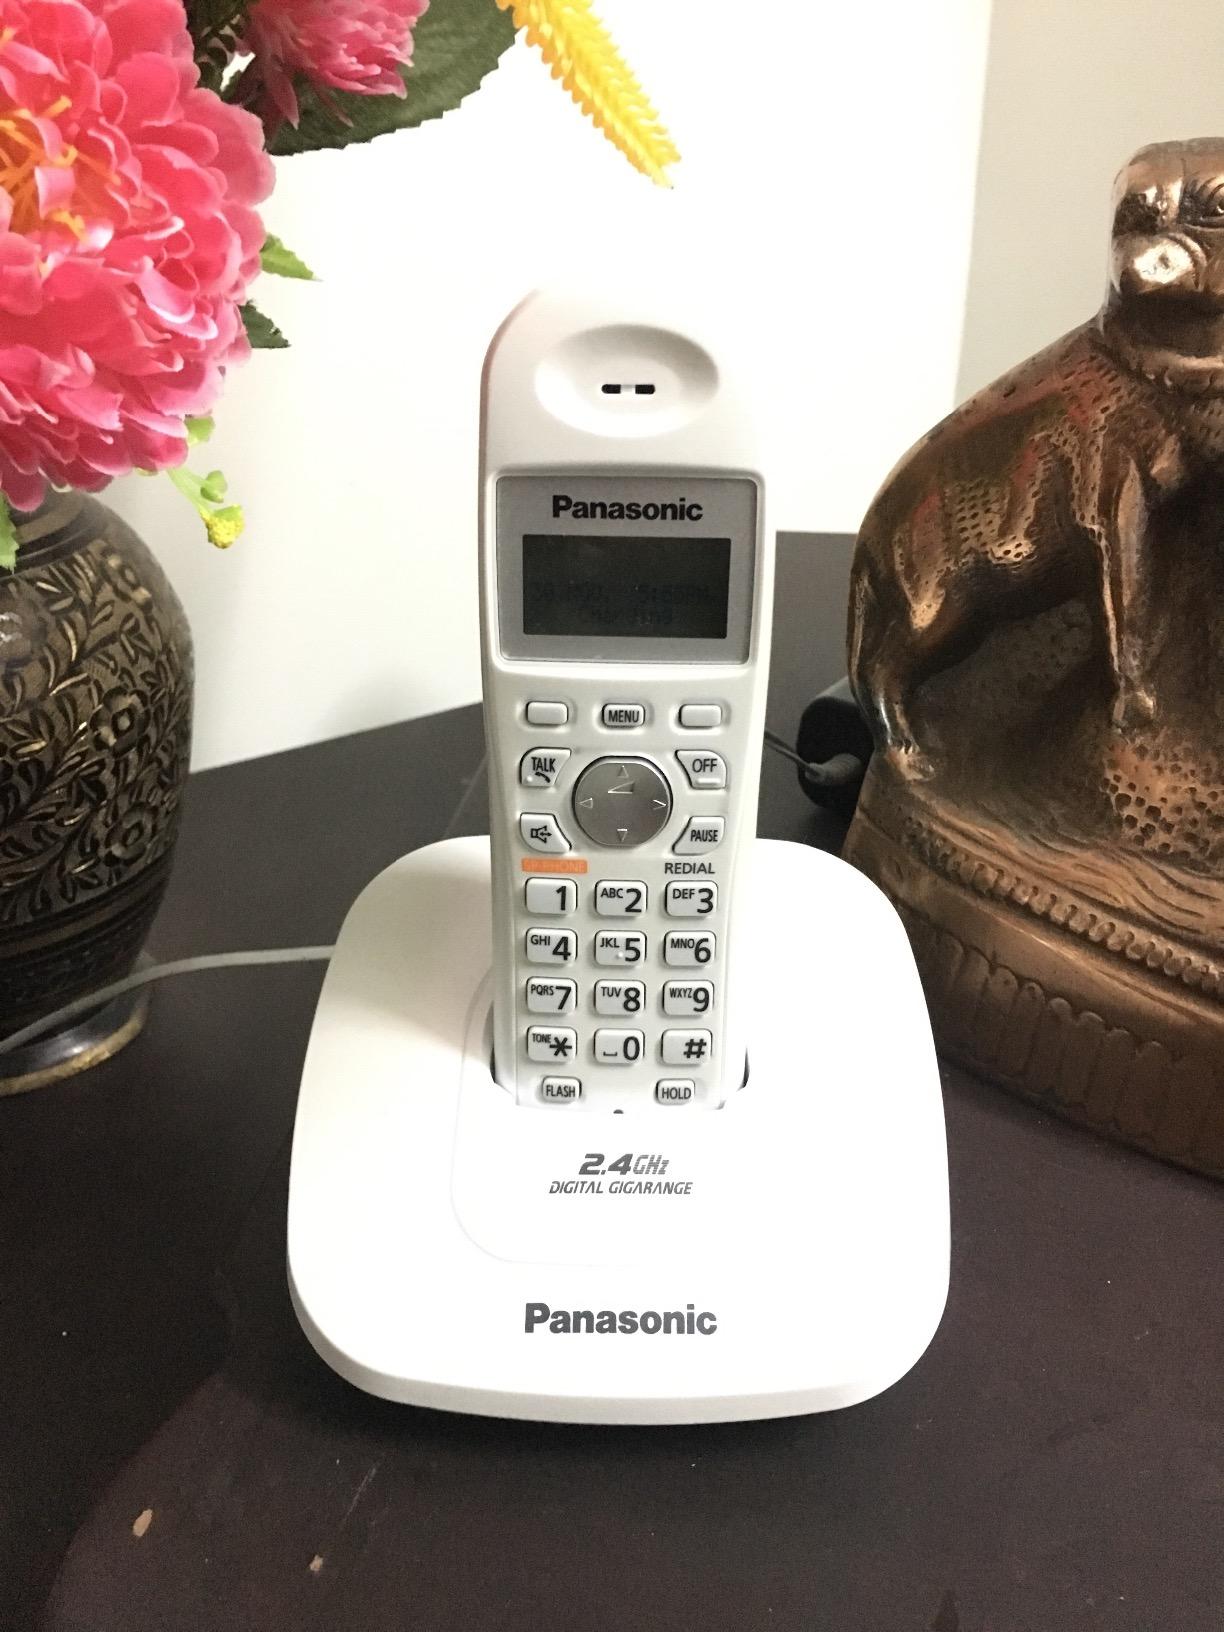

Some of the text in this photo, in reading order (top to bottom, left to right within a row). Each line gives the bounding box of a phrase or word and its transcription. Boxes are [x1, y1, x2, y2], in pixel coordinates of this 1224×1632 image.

[552, 494, 703, 521] Panasonic
[608, 710, 639, 723] MENU
[531, 756, 556, 773] TALK
[692, 758, 718, 773] OFF
[690, 829, 718, 842] PAUSE
[664, 862, 715, 874] REDIAL
[555, 885, 567, 911] 1
[600, 888, 642, 913] ABC 2
[672, 888, 714, 914] DEF 3
[530, 934, 571, 961] GHI 4
[600, 937, 641, 962] JKL 5
[670, 937, 711, 963] MNO 6
[530, 984, 572, 1010] PQRS 7
[600, 986, 641, 1012] TUV 8
[669, 987, 710, 1013] WXYZ 9
[532, 1033, 551, 1043] TONE
[623, 1036, 640, 1061] 0
[683, 1038, 707, 1059] #
[545, 1084, 576, 1098] FLASH
[661, 1086, 691, 1100] HOLD
[549, 1180, 693, 1195] DIGITAL GIGARANGE
[524, 1302, 718, 1335] Panasonic
